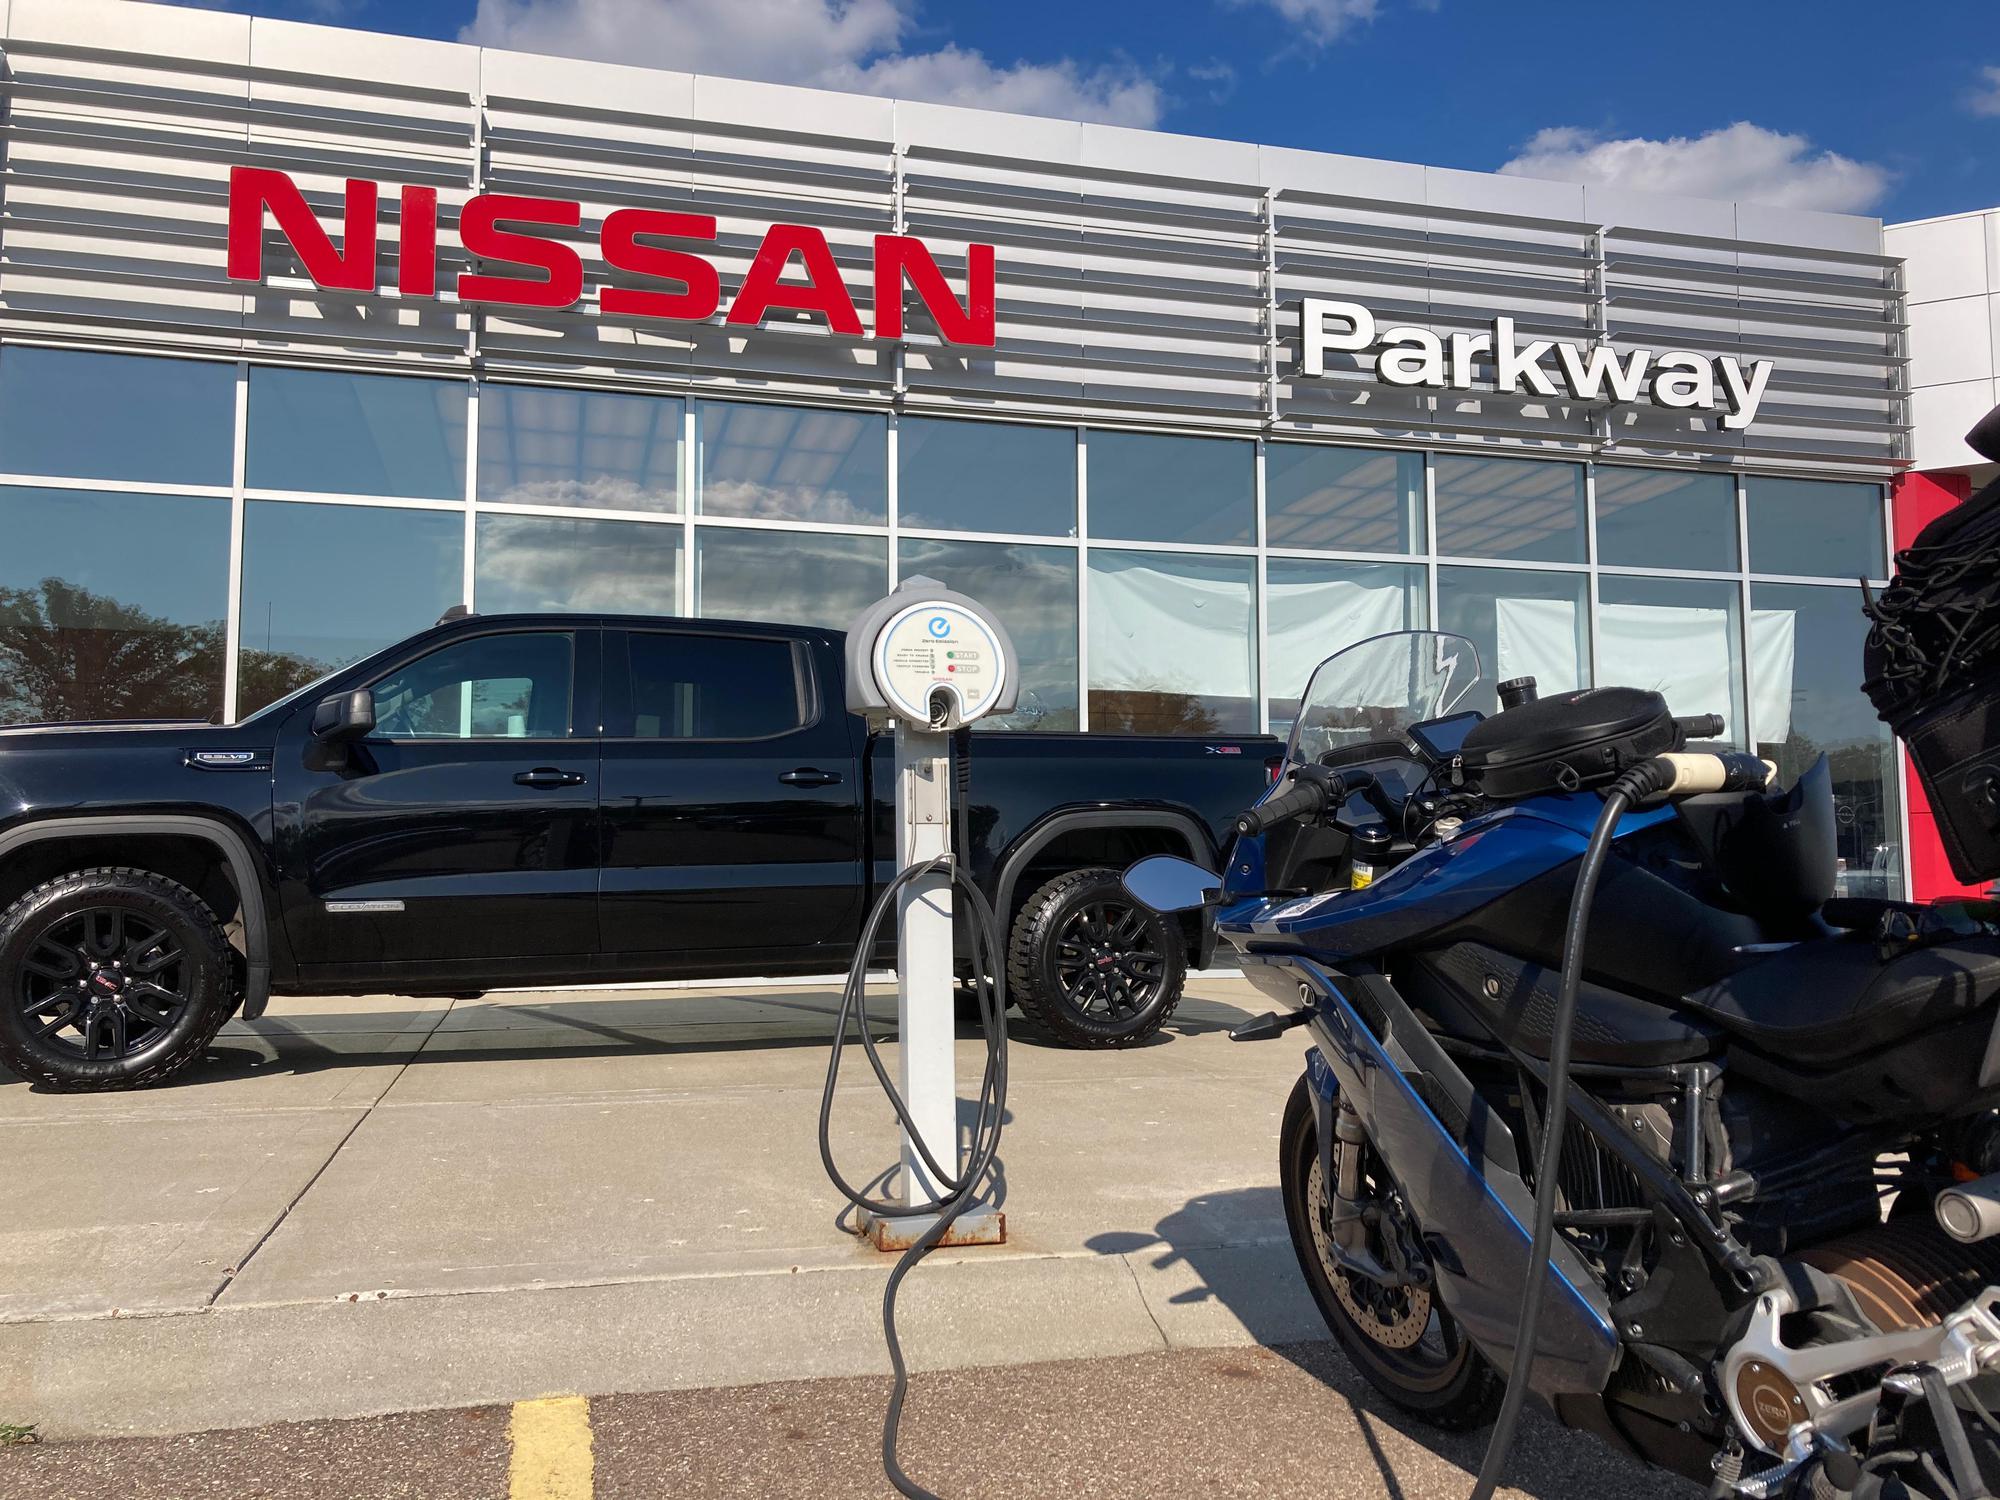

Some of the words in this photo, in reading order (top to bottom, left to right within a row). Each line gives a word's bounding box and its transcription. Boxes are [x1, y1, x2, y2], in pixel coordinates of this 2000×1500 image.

[227, 165, 996, 347] NISSAN
[1299, 297, 1775, 430] Parkway
[1758, 1401, 1787, 1418] ZERO
